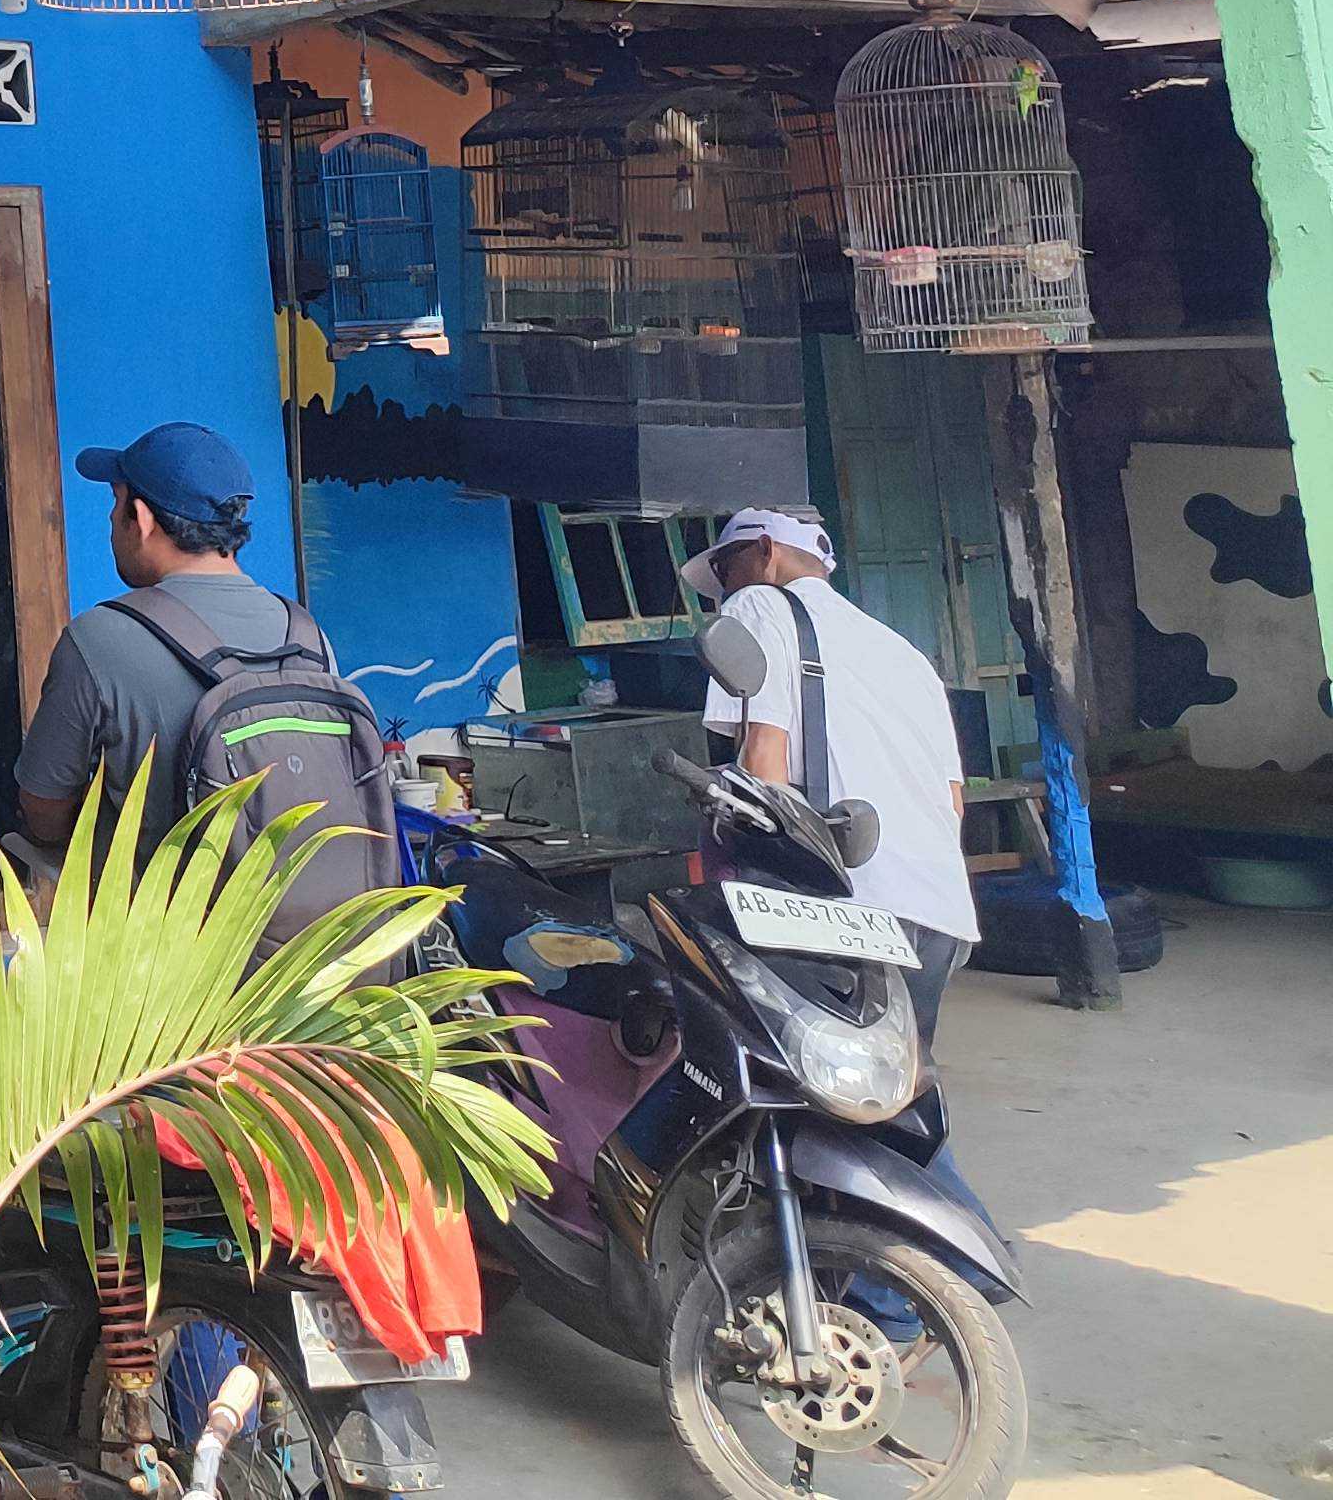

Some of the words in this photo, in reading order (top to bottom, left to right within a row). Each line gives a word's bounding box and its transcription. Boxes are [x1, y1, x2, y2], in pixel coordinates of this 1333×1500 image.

[736, 890, 771, 913] AB
[784, 899, 852, 927] 6570
[860, 910, 898, 935] KY
[683, 1059, 723, 1102] YAMAHA
